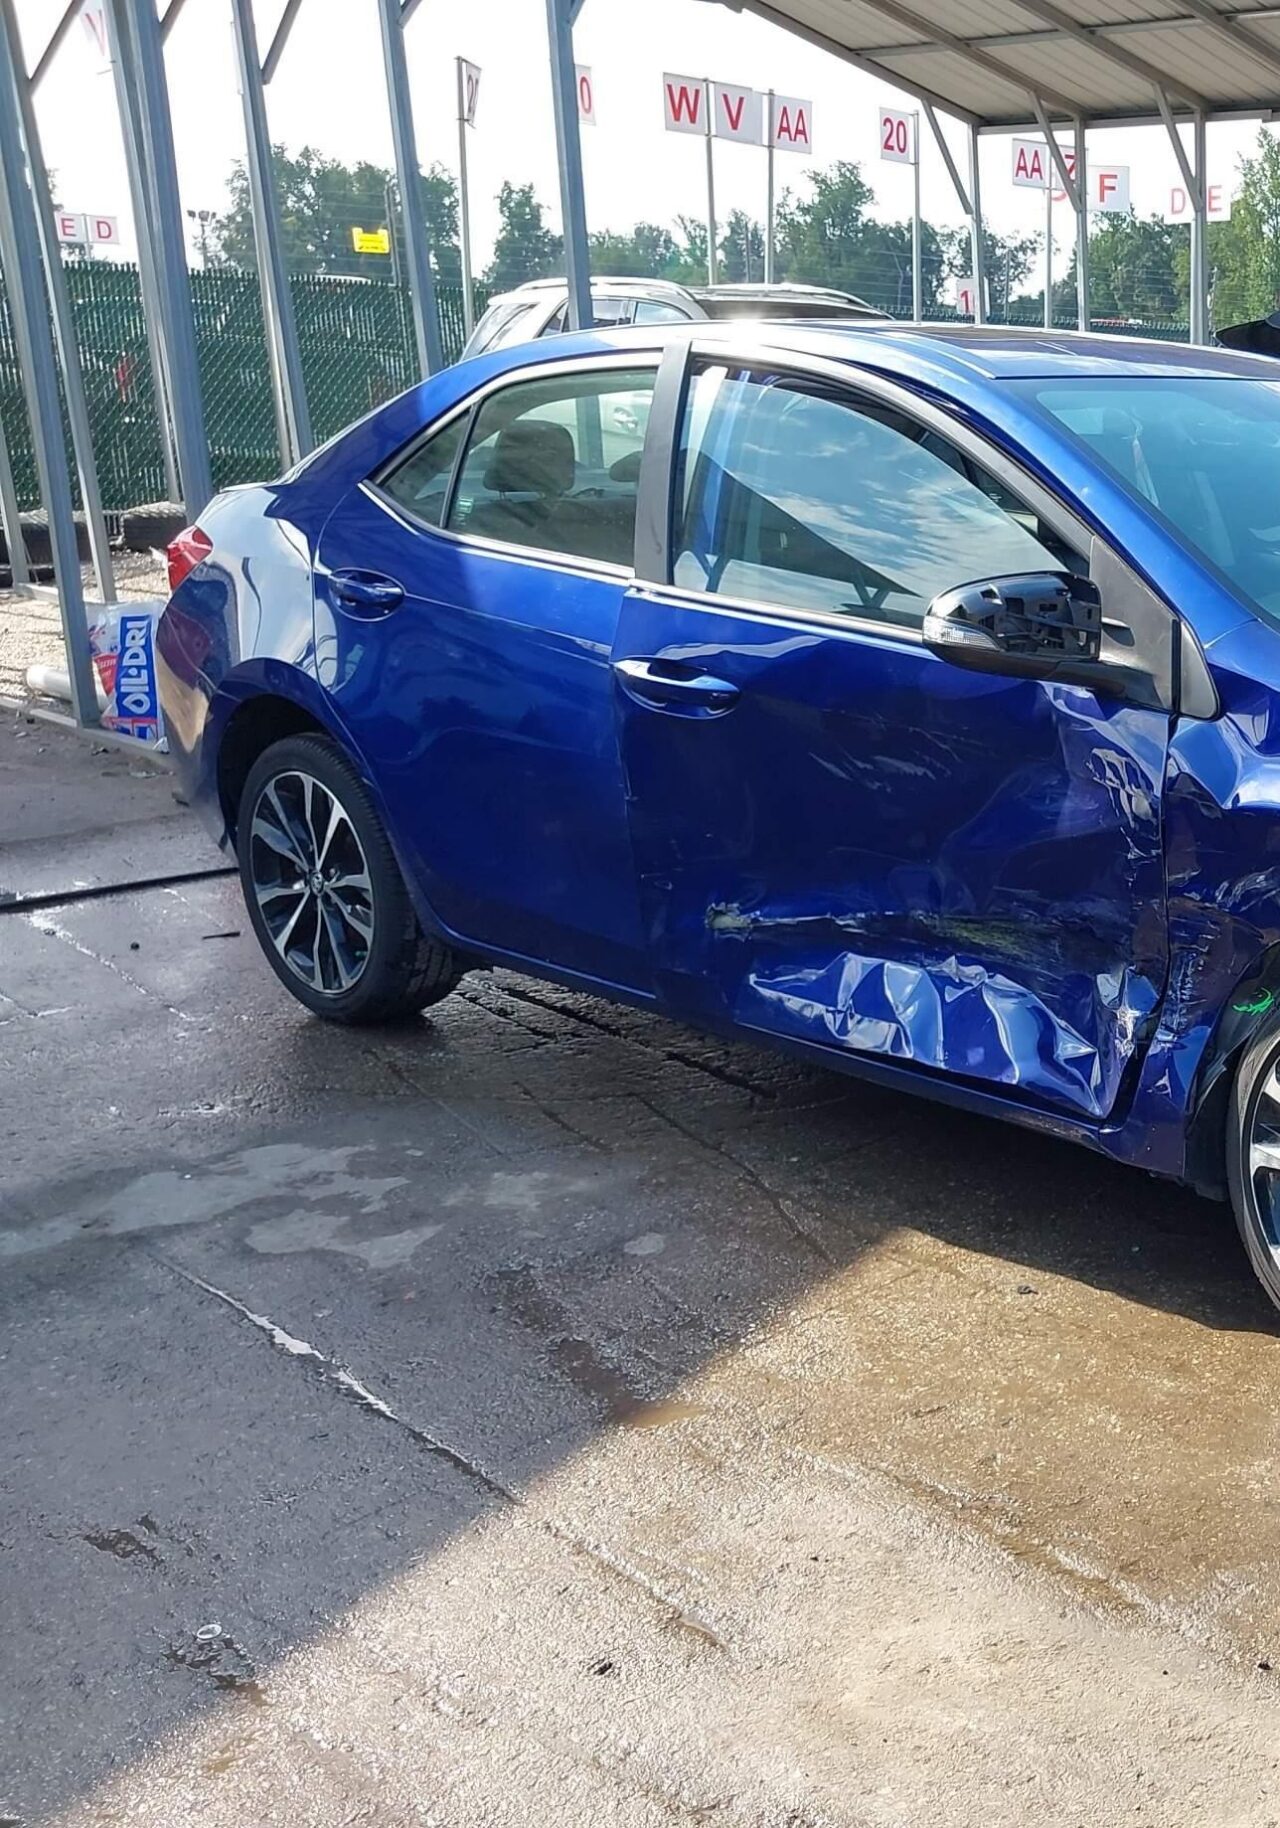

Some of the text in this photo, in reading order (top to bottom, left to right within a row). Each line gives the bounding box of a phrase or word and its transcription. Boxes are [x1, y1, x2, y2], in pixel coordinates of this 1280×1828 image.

[666, 84, 700, 124] W
[722, 94, 744, 131] V
[777, 106, 809, 144] AA
[883, 117, 907, 153] 20
[1015, 148, 1043, 180] AA
[1099, 174, 1118, 202] F
[1171, 188, 1186, 215] D
[1207, 185, 1222, 212] E
[61, 218, 77, 237] E
[96, 220, 112, 239] D
